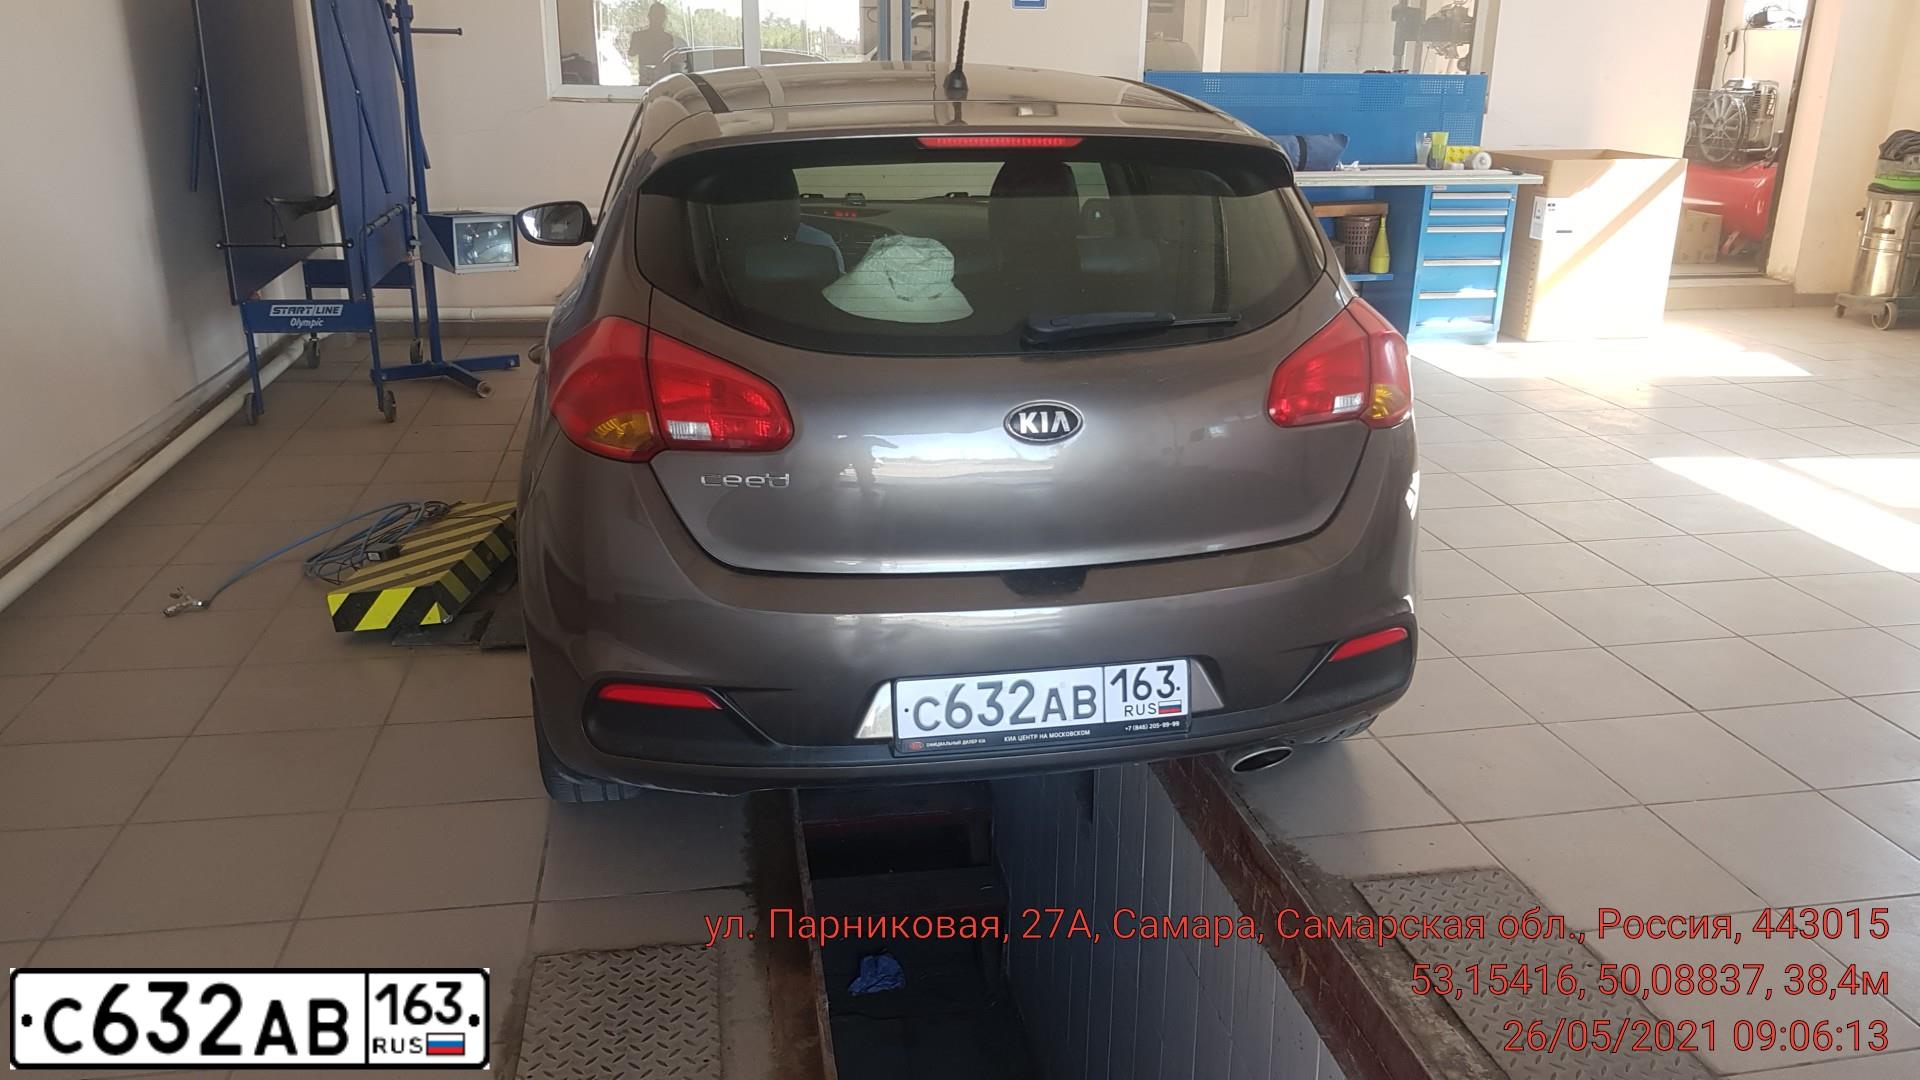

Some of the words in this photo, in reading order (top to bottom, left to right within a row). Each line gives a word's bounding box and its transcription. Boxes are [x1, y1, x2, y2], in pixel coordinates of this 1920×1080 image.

[272, 306, 313, 315] START
[315, 306, 340, 315] LINE
[290, 318, 325, 329] Olympic
[1018, 411, 1071, 434] KIA
[1110, 664, 1175, 703] 163
[1124, 702, 1157, 717] RUS
[1018, 733, 1038, 741] ЦЕНТР
[1049, 729, 1091, 739] МОСКОВСКОМ
